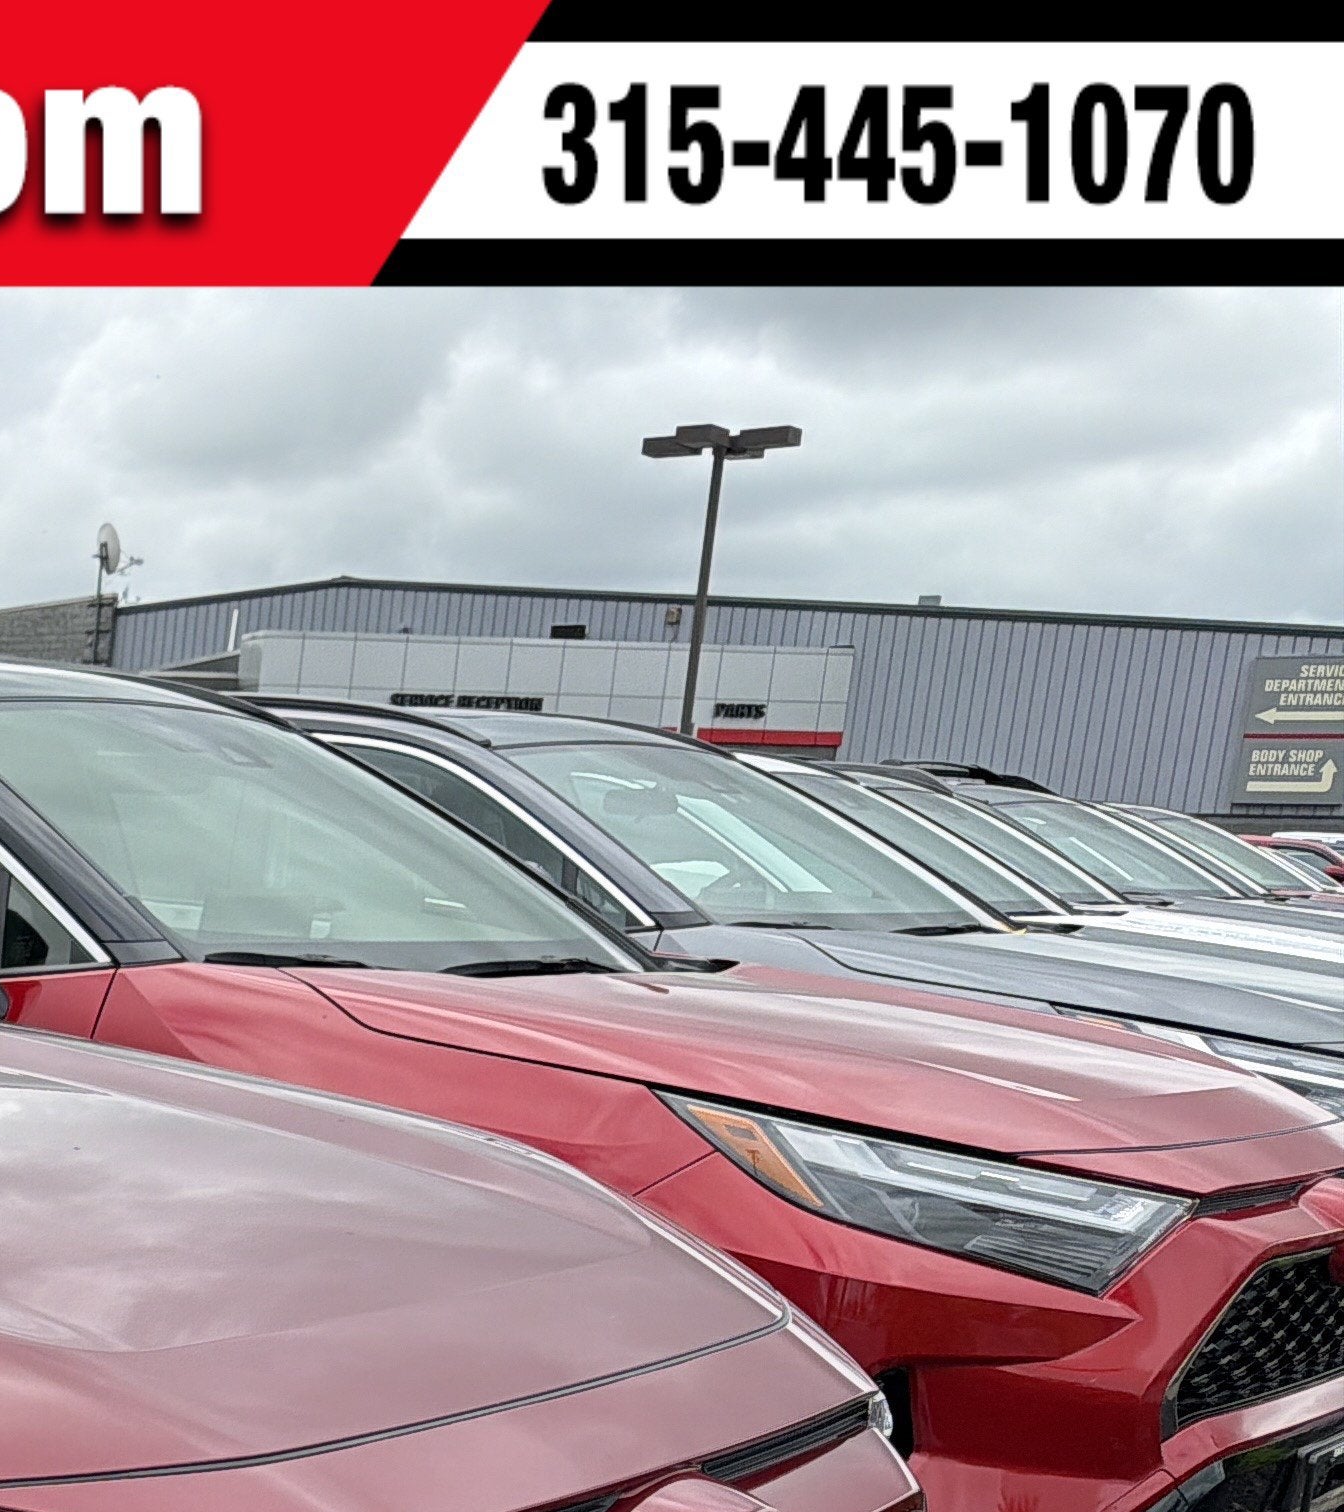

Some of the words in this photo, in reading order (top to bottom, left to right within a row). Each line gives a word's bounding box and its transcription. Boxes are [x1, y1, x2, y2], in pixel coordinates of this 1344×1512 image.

[1251, 749, 1286, 762] BODY
[1288, 750, 1324, 762] SHOP
[1248, 763, 1316, 776] ENTRANCE
